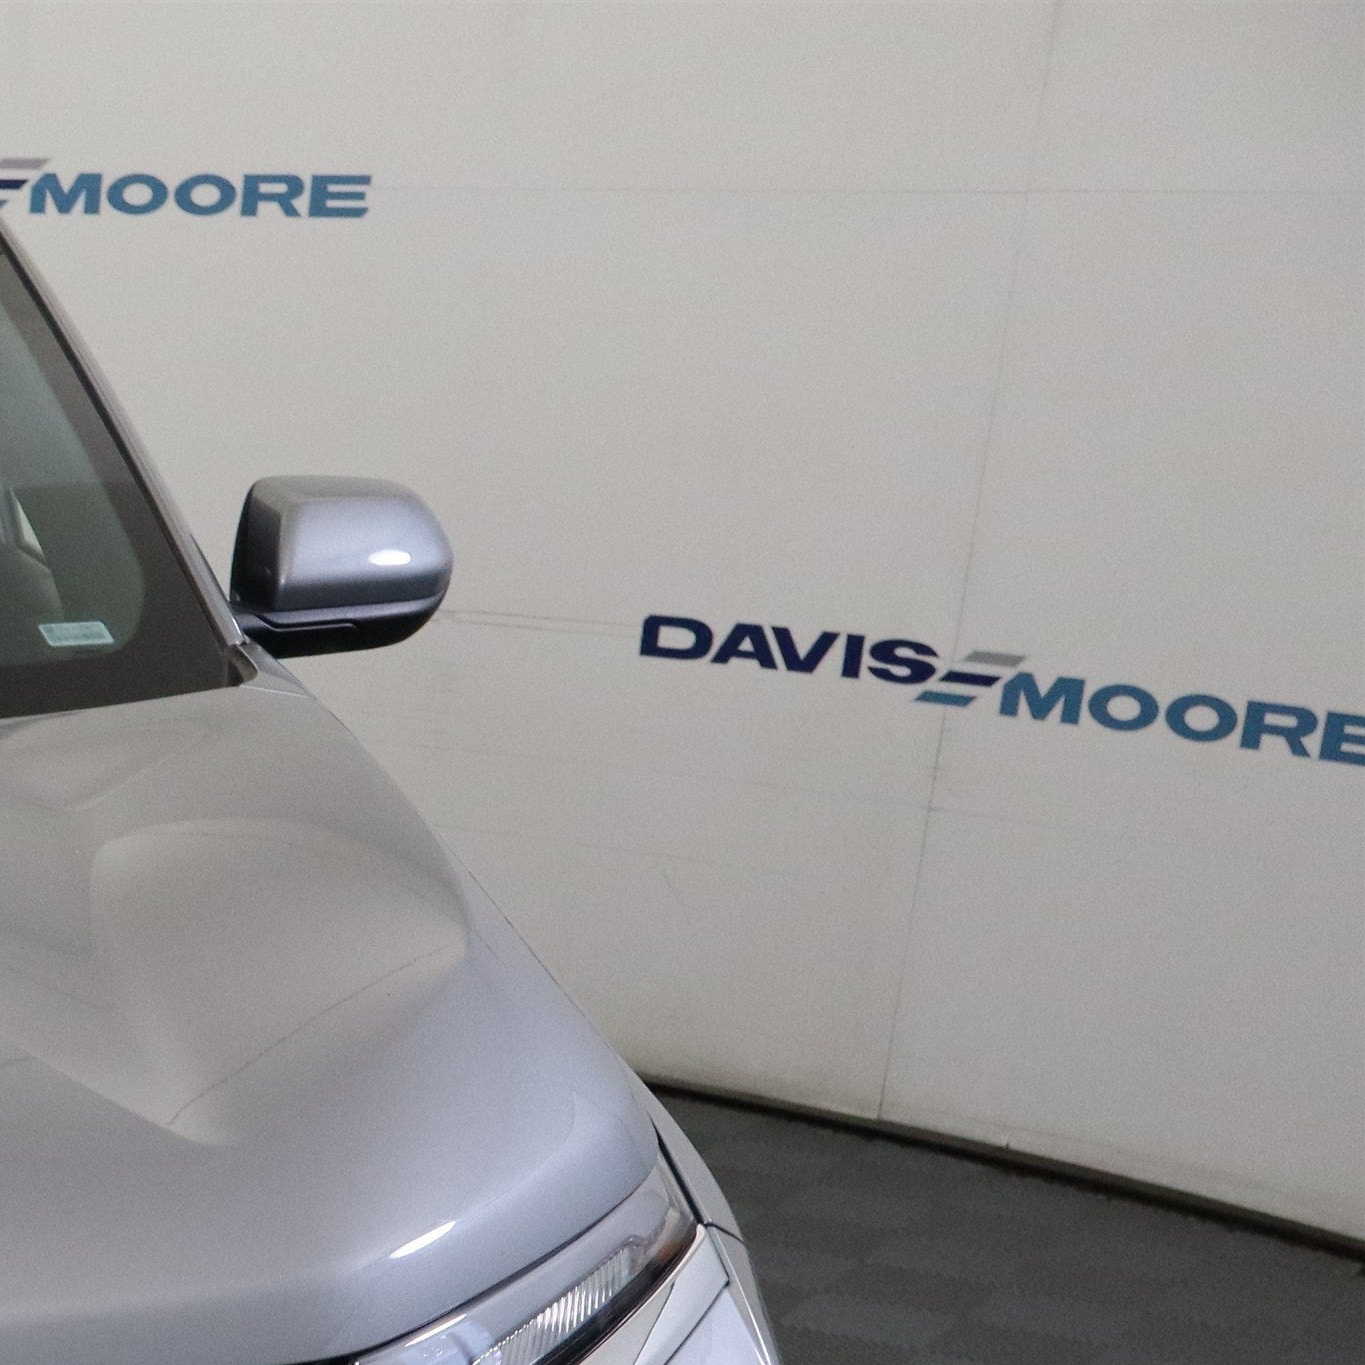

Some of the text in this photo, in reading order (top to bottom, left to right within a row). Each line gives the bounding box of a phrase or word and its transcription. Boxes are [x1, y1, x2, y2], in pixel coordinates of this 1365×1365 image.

[30, 172, 372, 219] MOORE
[639, 615, 1365, 766] DAVIS MOORE
